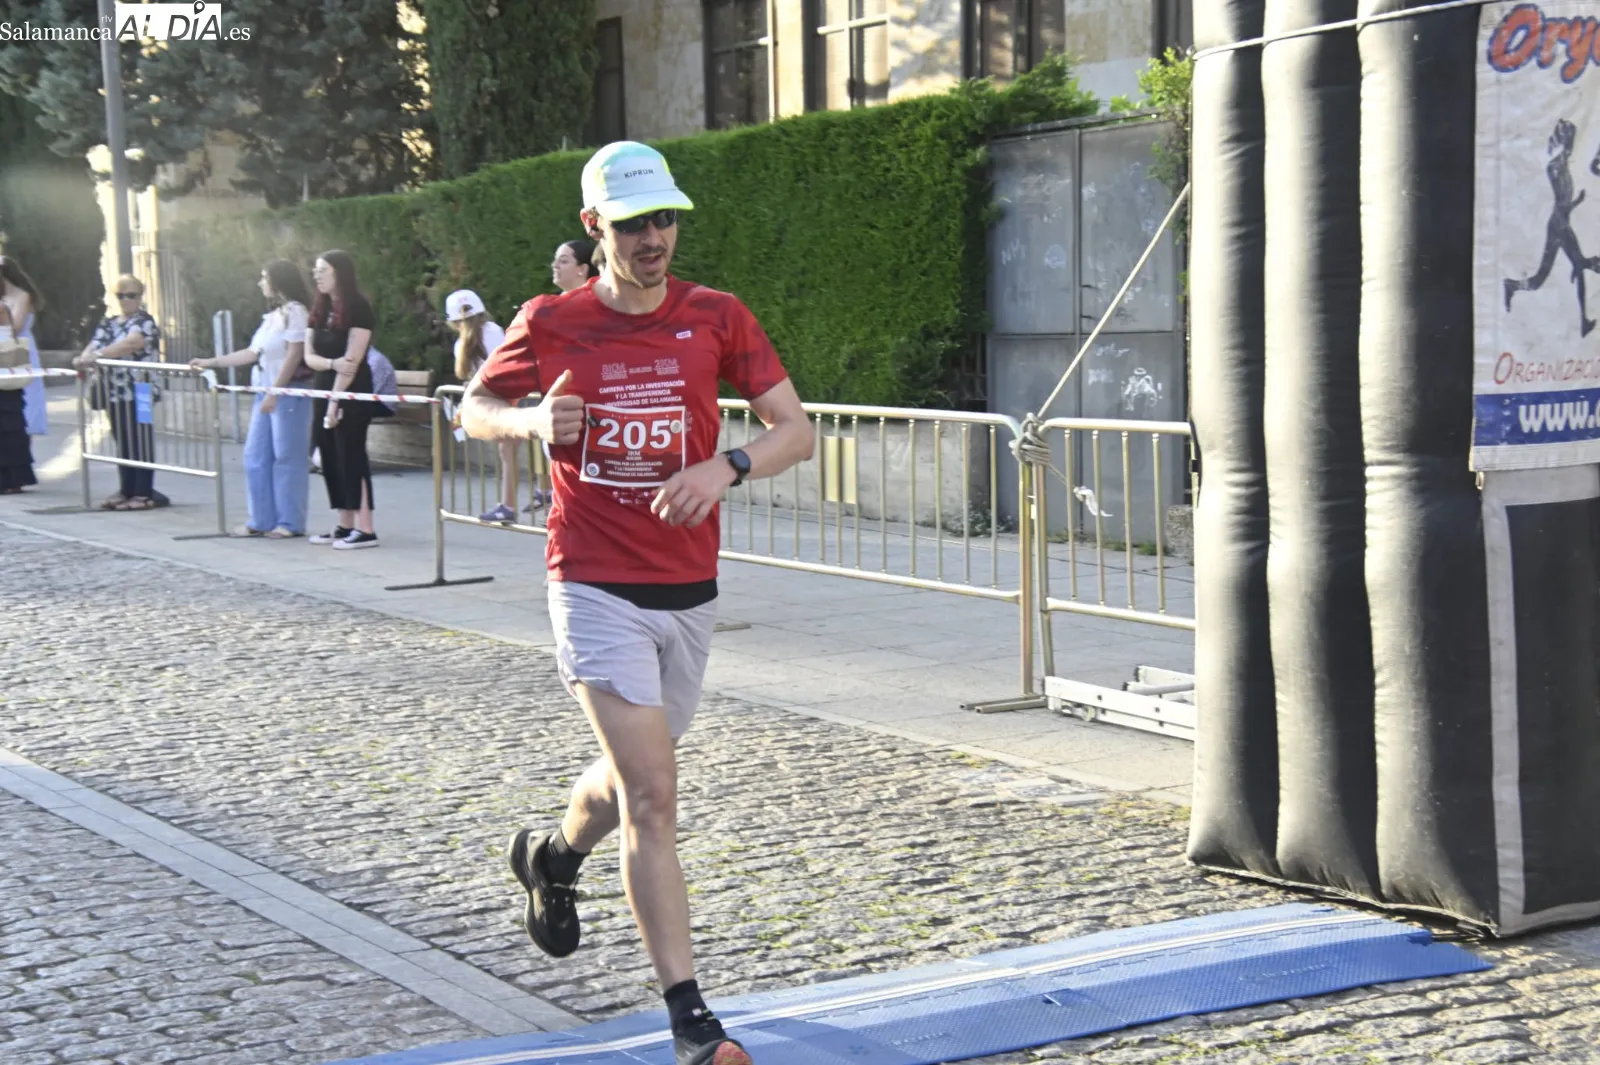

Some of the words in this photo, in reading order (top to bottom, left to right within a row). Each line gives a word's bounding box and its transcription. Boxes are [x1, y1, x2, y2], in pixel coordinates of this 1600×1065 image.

[624, 168, 654, 179] KIPRUN
[599, 385, 625, 394] CARRERA
[646, 380, 686, 389] INVESTIGACIÓN
[628, 389, 671, 398] TRANSFERENCIA
[650, 396, 682, 404] SALAMANCA
[597, 418, 671, 450] 205
